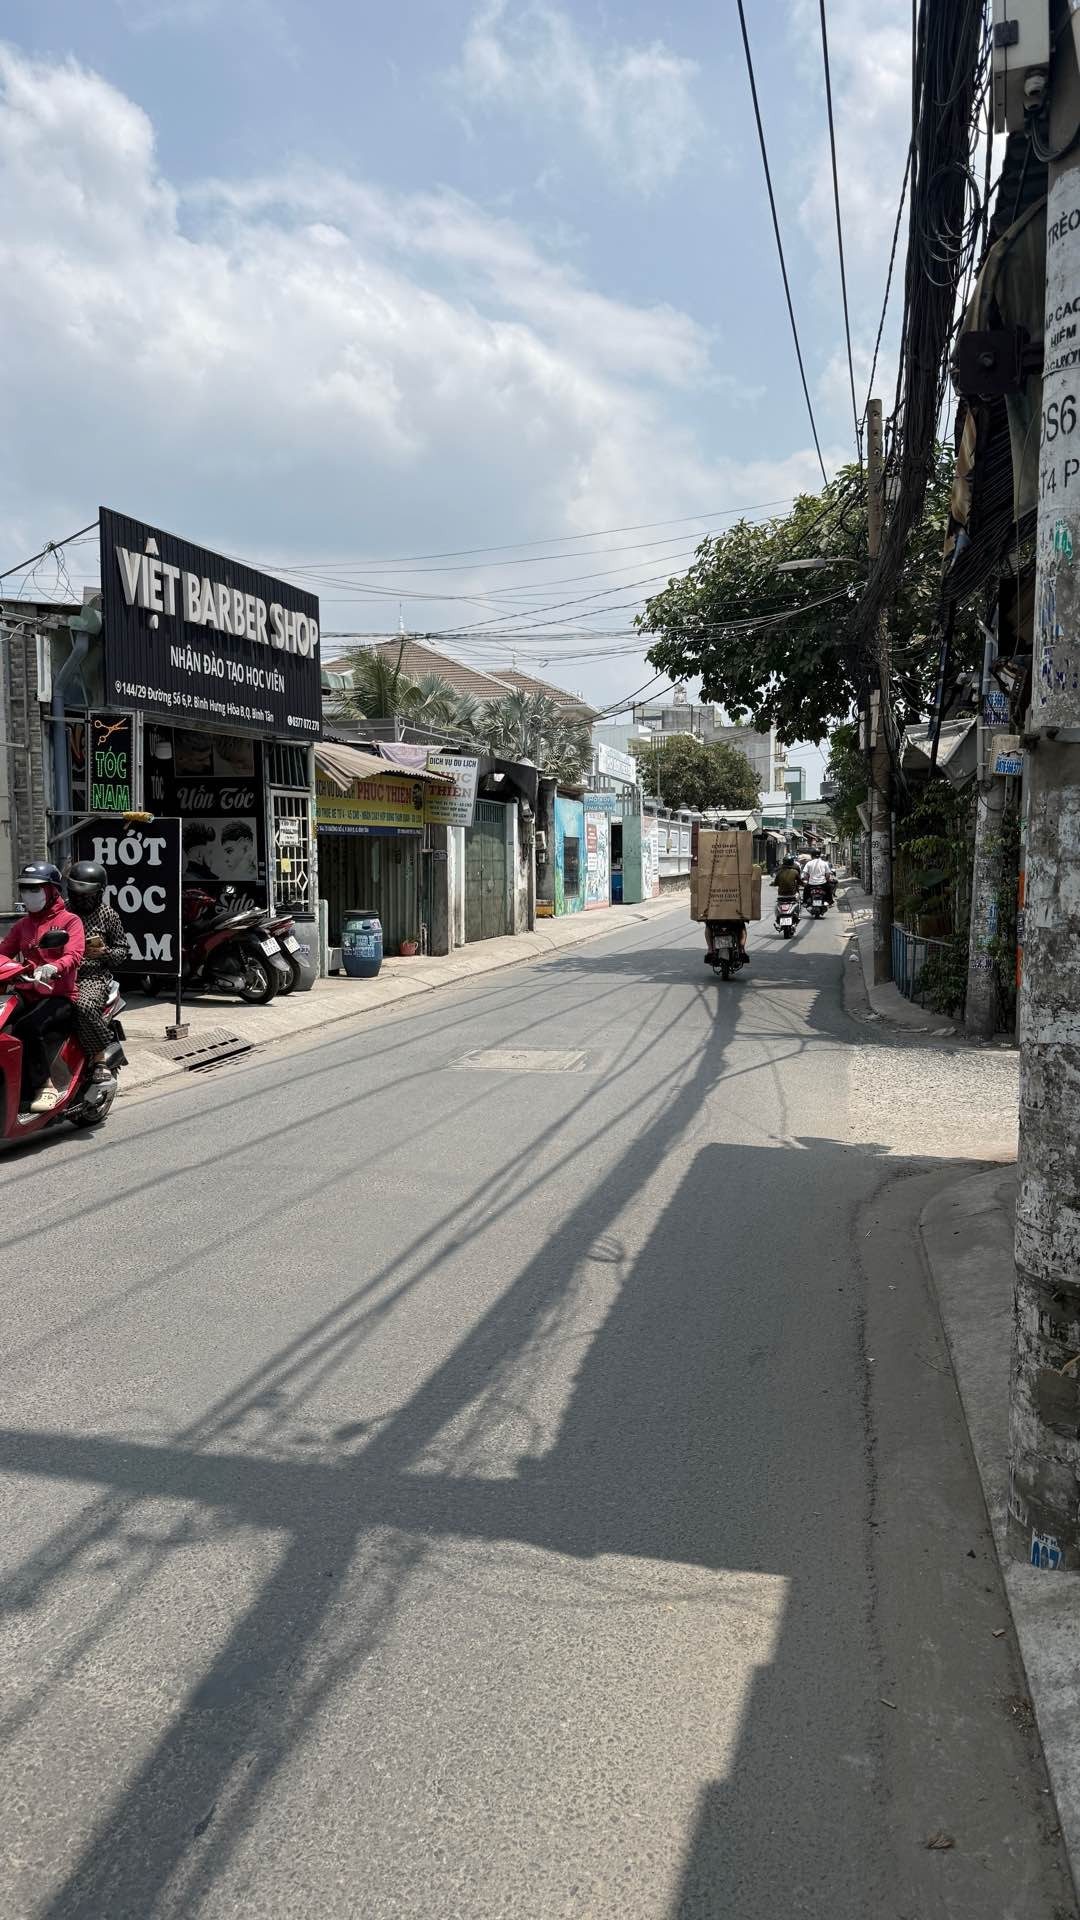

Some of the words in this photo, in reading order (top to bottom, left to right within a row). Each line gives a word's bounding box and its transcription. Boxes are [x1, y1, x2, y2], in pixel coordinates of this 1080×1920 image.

[116, 537, 180, 630] VIỆT
[182, 571, 269, 646] BARBER
[269, 602, 319, 660] SHOP
[170, 644, 201, 676] NHẬN
[203, 650, 225, 679] ĐÀO
[226, 660, 245, 687] TẠO
[245, 665, 265, 692] HỌC
[265, 667, 285, 694] VIÊN
[122, 681, 147, 699] 144/29
[147, 686, 172, 707] Đường
[172, 691, 181, 705] Số
[193, 695, 209, 711] Bình
[209, 699, 227, 717] Hưng
[226, 702, 240, 716] Hòa
[251, 707, 265, 721] Bình
[95, 745, 127, 779] TÓC
[92, 783, 131, 811] NAM
[176, 785, 215, 811] Uốn
[219, 787, 255, 810] Tóc
[91, 829, 167, 866] HỚT
[126, 932, 173, 962] AM
